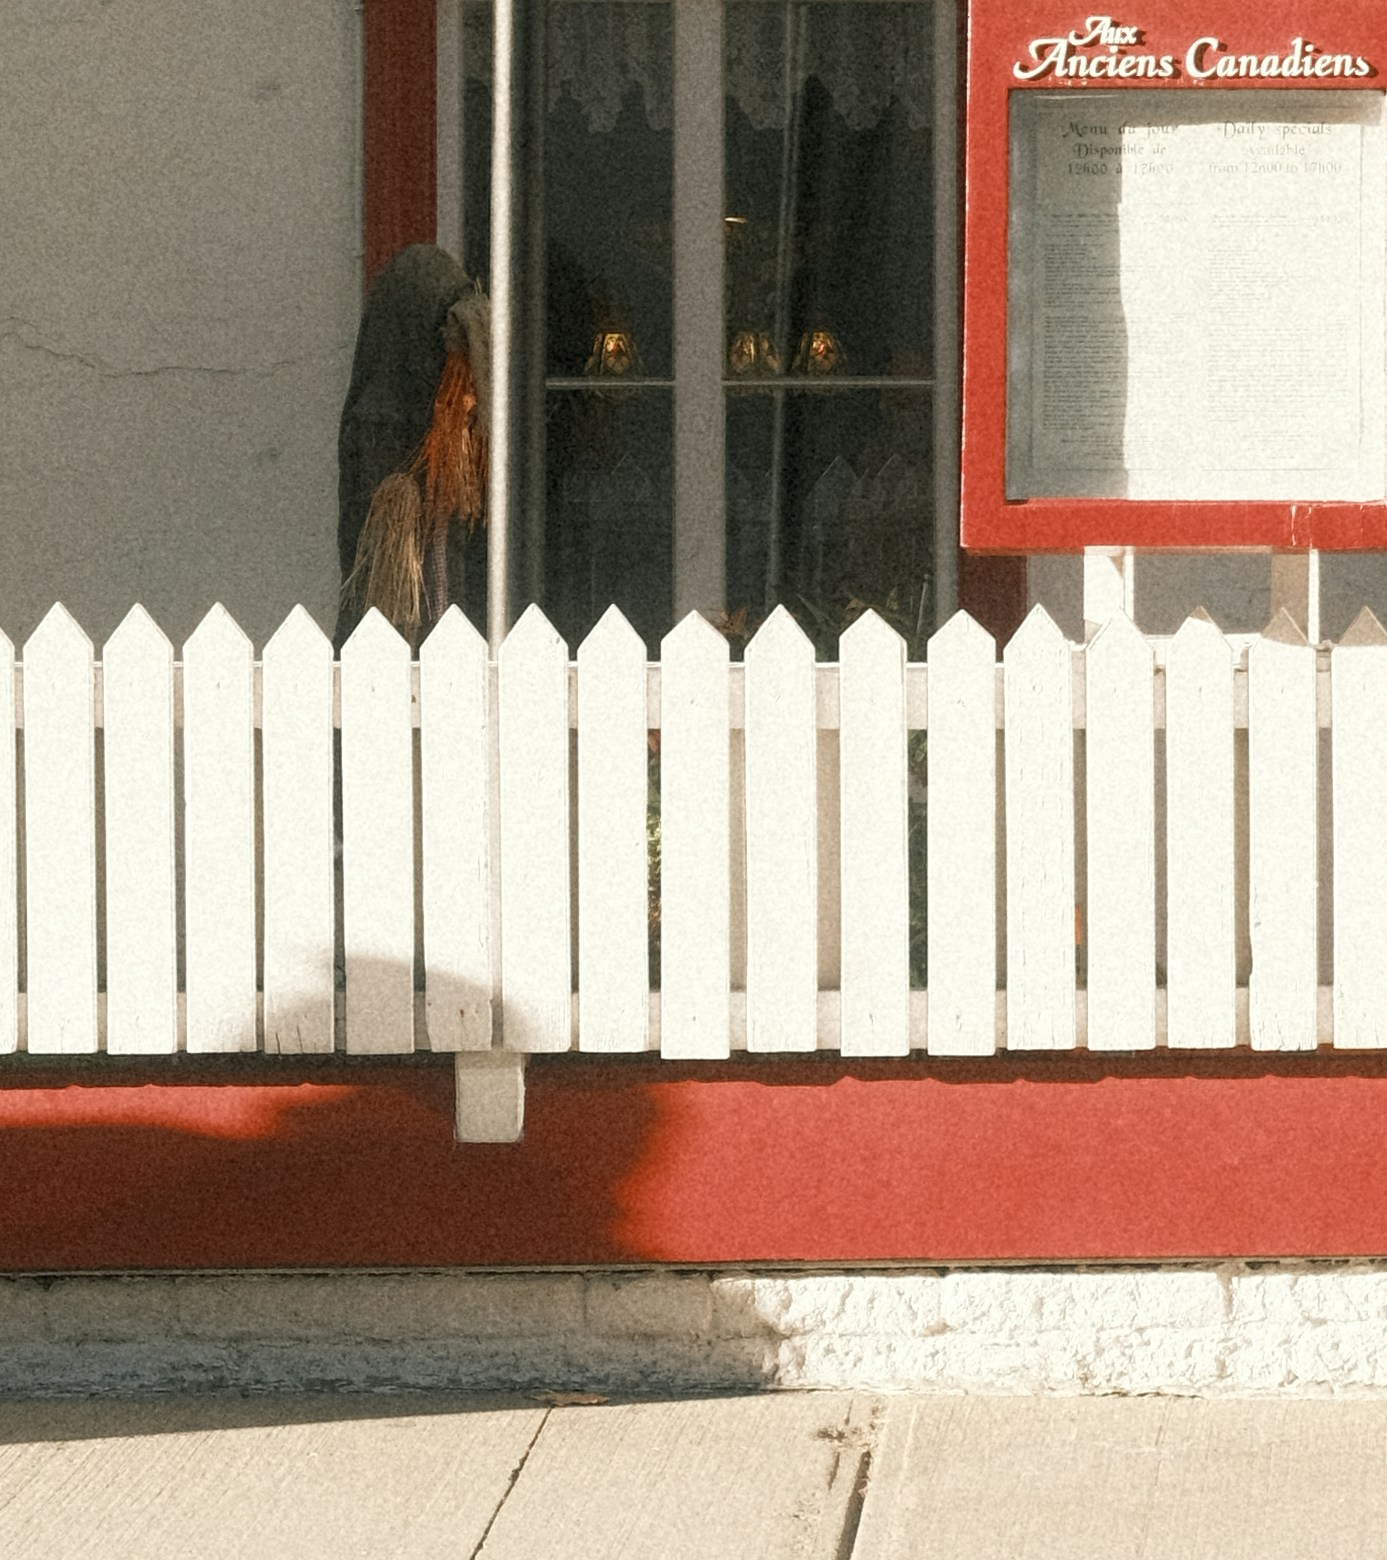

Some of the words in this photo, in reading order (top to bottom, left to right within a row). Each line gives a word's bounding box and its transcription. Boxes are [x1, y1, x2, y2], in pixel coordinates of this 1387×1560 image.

[1069, 15, 1138, 45] Aux
[1013, 36, 1174, 80] Anciens
[1185, 34, 1371, 79] Canadiens
[1062, 122, 1107, 138] Menu
[1118, 121, 1137, 135] du
[1144, 122, 1179, 141] jour
[1217, 120, 1266, 141] Daily
[1072, 143, 1145, 158] Disponible
